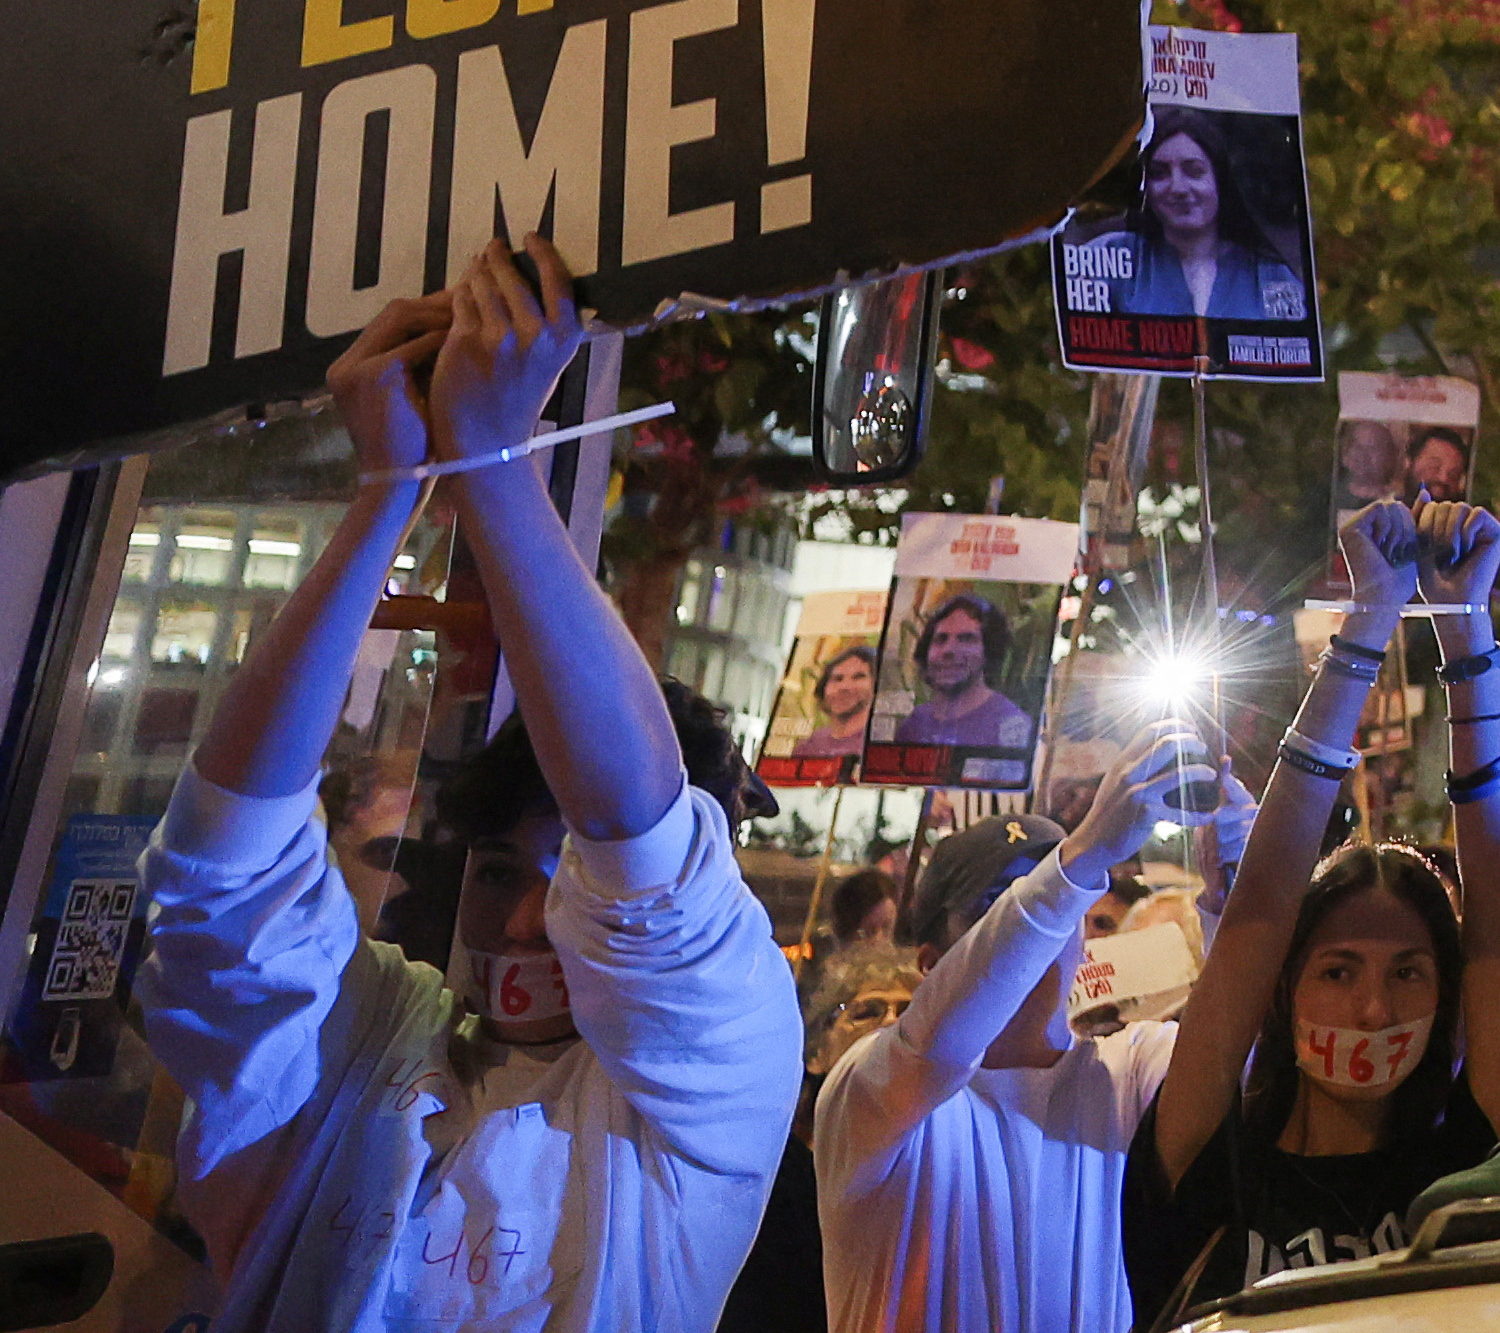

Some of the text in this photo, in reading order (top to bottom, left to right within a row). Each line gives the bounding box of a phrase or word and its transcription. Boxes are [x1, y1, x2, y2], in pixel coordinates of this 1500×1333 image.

[1180, 60, 1215, 80] ARIEV
[1063, 243, 1133, 279] BRING
[1066, 278, 1111, 313] HER
[1069, 316, 1135, 351] HOME
[1308, 1029, 1415, 1083] 467
[422, 1225, 526, 1285] 467
